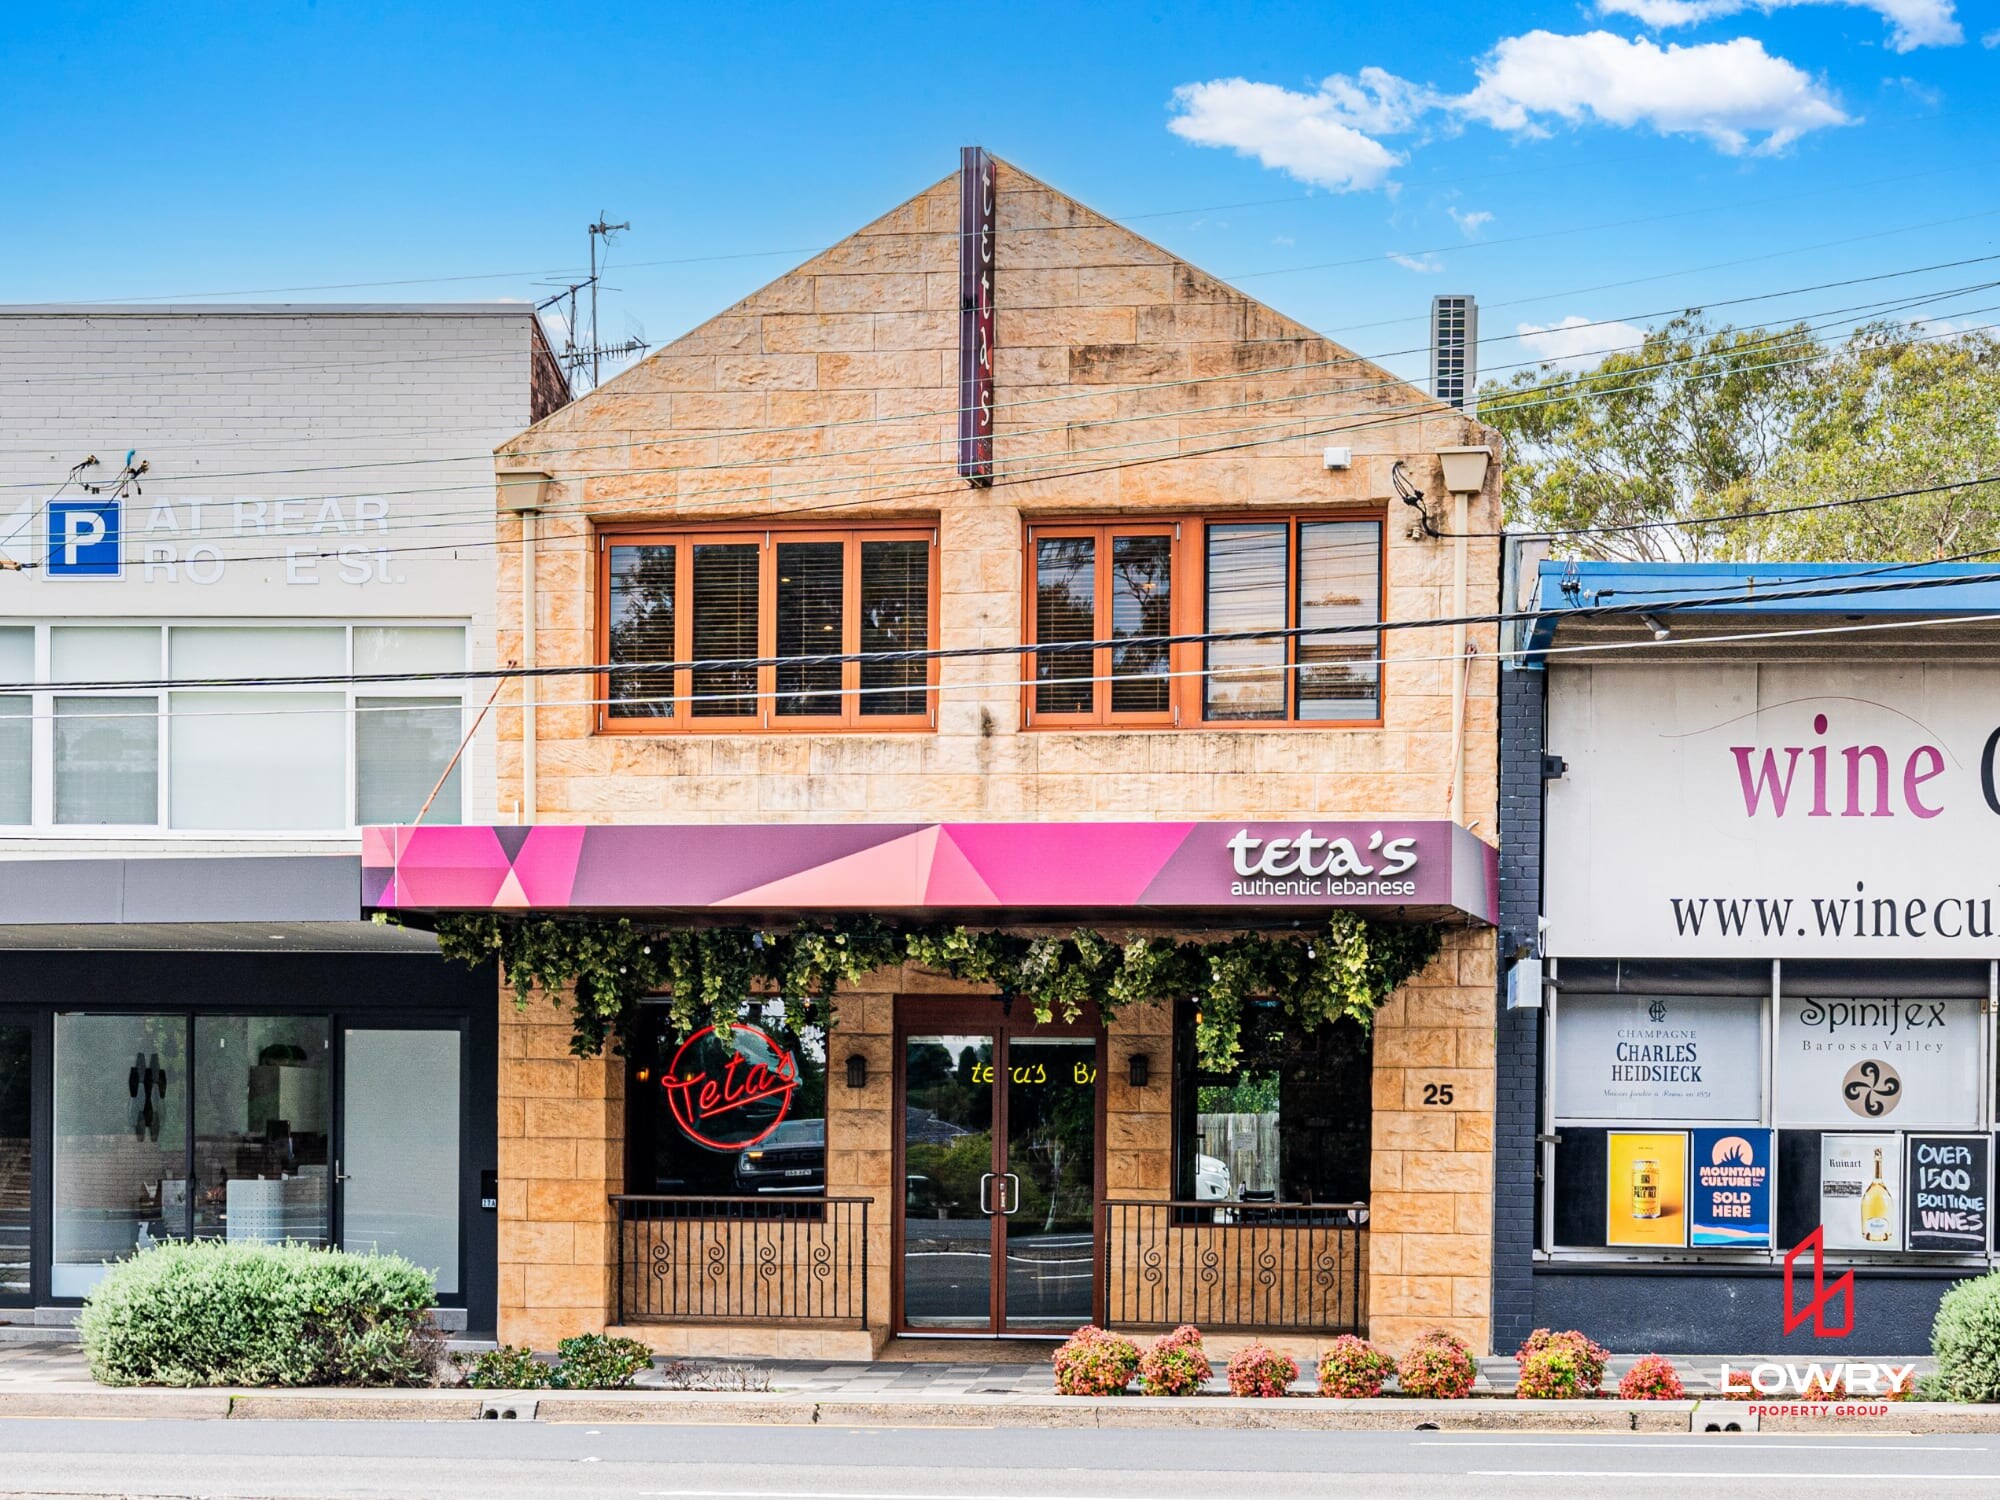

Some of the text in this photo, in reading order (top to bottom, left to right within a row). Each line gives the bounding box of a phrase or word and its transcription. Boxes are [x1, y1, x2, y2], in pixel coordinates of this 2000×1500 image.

[143, 496, 392, 537] AT REAR
[64, 511, 106, 565] P
[337, 543, 407, 585] St.
[1729, 713, 1945, 819] wine
[1226, 828, 1418, 877] teta's
[1231, 877, 1416, 896] authentic lebanese
[1670, 881, 2000, 938] www.winecu
[1617, 1029, 1697, 1039] CHAMPAGNE
[1616, 1041, 1697, 1063] CHARLES
[1611, 1064, 1703, 1082] HEIDSIECK
[1423, 1084, 1454, 1106] 25
[1917, 1144, 1972, 1165] OVER
[1699, 1166, 1766, 1177] MOUNTAIN
[1701, 1176, 1752, 1188] CULTURE
[1919, 1166, 1971, 1192] 1500
[1712, 1191, 1752, 1205] SOLD
[1917, 1192, 1986, 1212] BOUTIQUE
[1712, 1204, 1752, 1218] HERE
[1921, 1210, 1985, 1232] WINES
